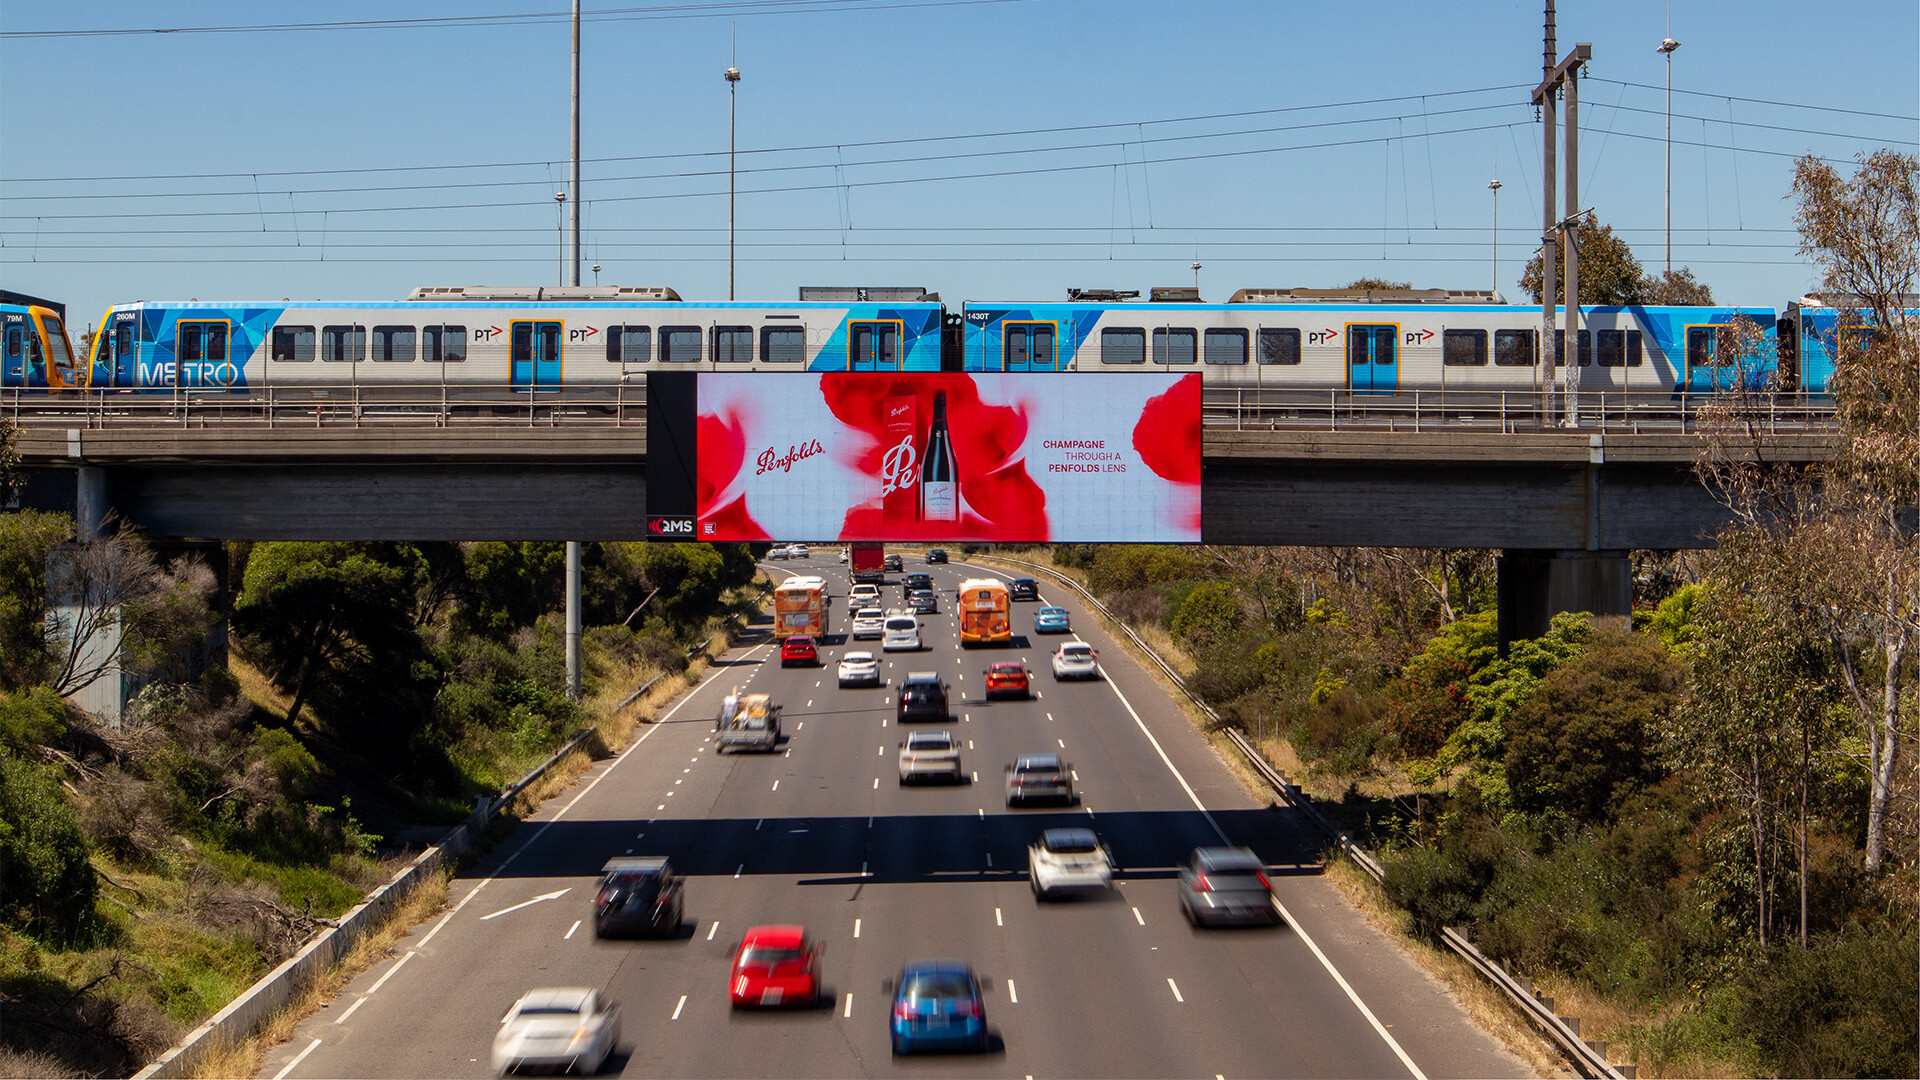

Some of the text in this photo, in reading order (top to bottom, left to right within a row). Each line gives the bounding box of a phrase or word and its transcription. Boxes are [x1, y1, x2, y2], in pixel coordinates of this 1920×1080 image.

[967, 312, 989, 320] 1430T
[140, 362, 238, 386] METRO
[1043, 440, 1105, 449] CHAMPAGNE
[756, 438, 823, 475] Penfolds
[1065, 452, 1122, 461] THROUGH A
[1049, 464, 1127, 473] PENFOLDS LENS
[655, 517, 693, 534] QMS
